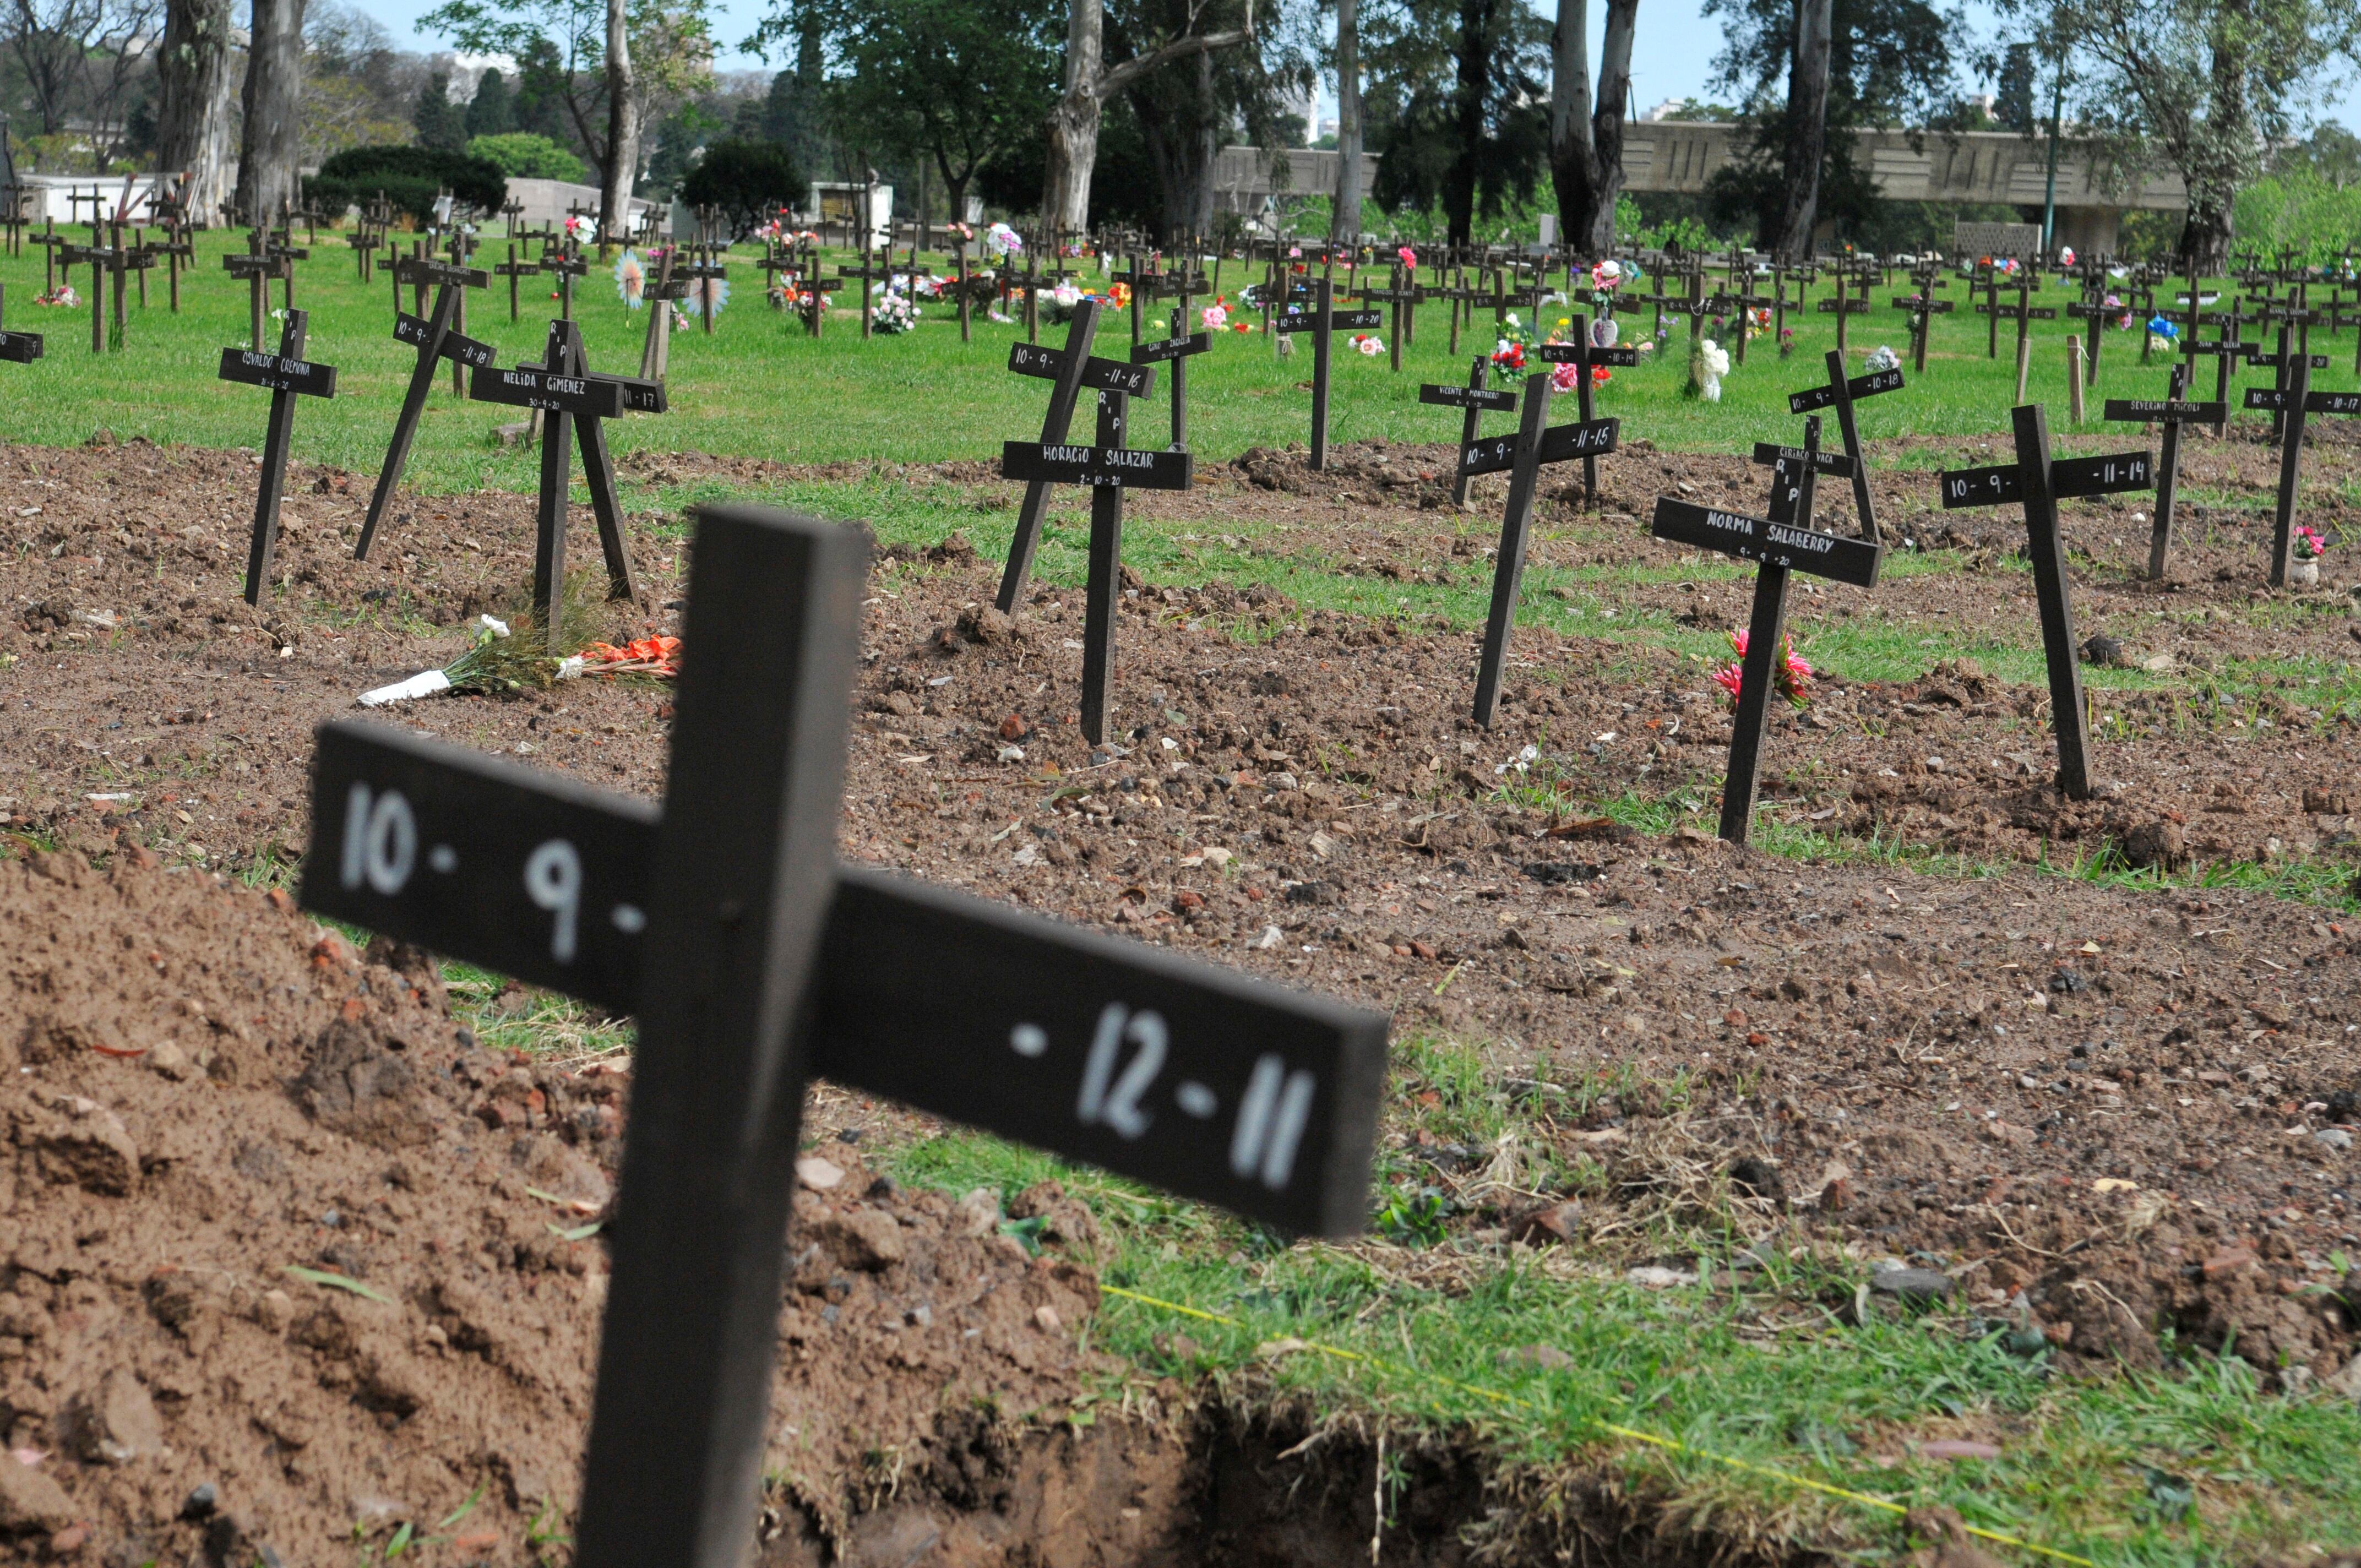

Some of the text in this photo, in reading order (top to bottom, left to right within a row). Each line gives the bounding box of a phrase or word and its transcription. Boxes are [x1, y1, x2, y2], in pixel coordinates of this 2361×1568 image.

[1351, 314, 1379, 324] -10-20
[242, 351, 310, 377] OSVALDO CREMONA
[1105, 368, 1141, 388] -11-16
[1867, 373, 1898, 390] -10-18
[1572, 427, 1609, 448] -11-15
[1105, 449, 1154, 469] SALAZAR
[1816, 453, 1834, 465] VACA
[2092, 460, 2145, 483] -11-14
[1706, 510, 1835, 554] NORMA SALABERRY
